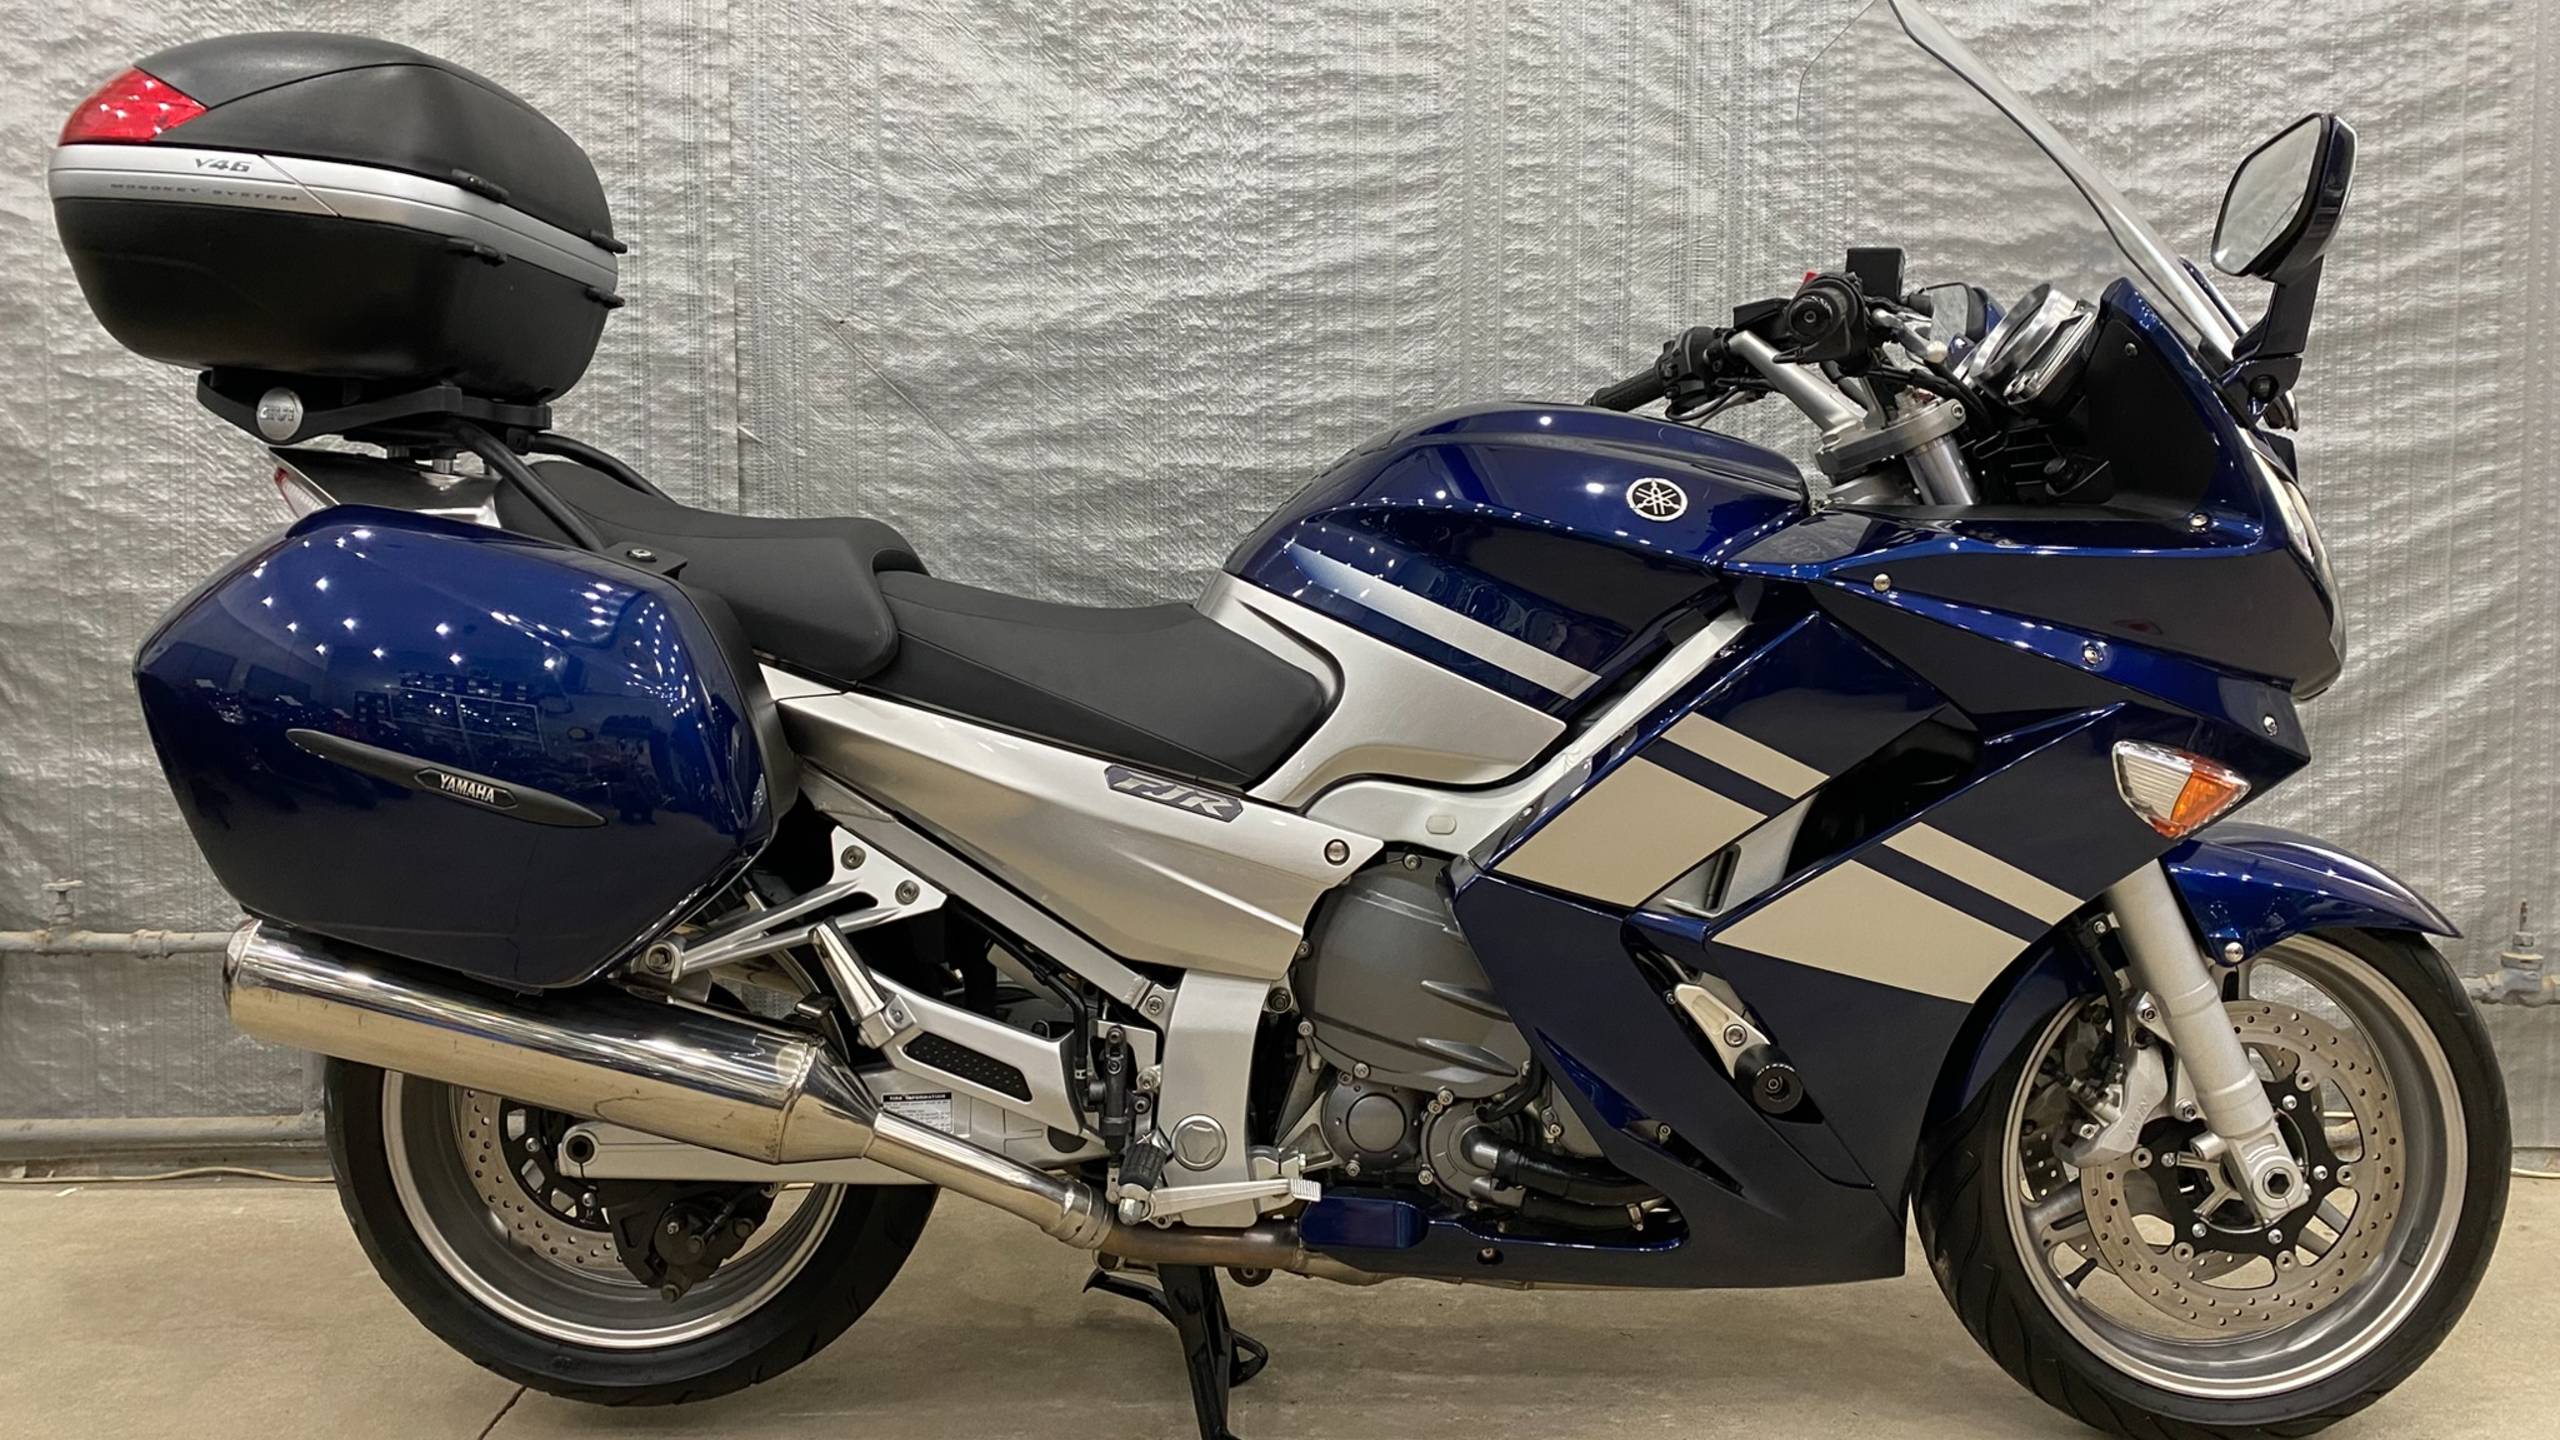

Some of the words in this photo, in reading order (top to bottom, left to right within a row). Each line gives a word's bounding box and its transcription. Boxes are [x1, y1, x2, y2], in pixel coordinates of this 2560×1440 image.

[195, 158, 251, 173] V46
[212, 190, 297, 201] SYSTEM
[440, 773, 495, 803] YAMAHA
[1112, 771, 1233, 817] FJR
